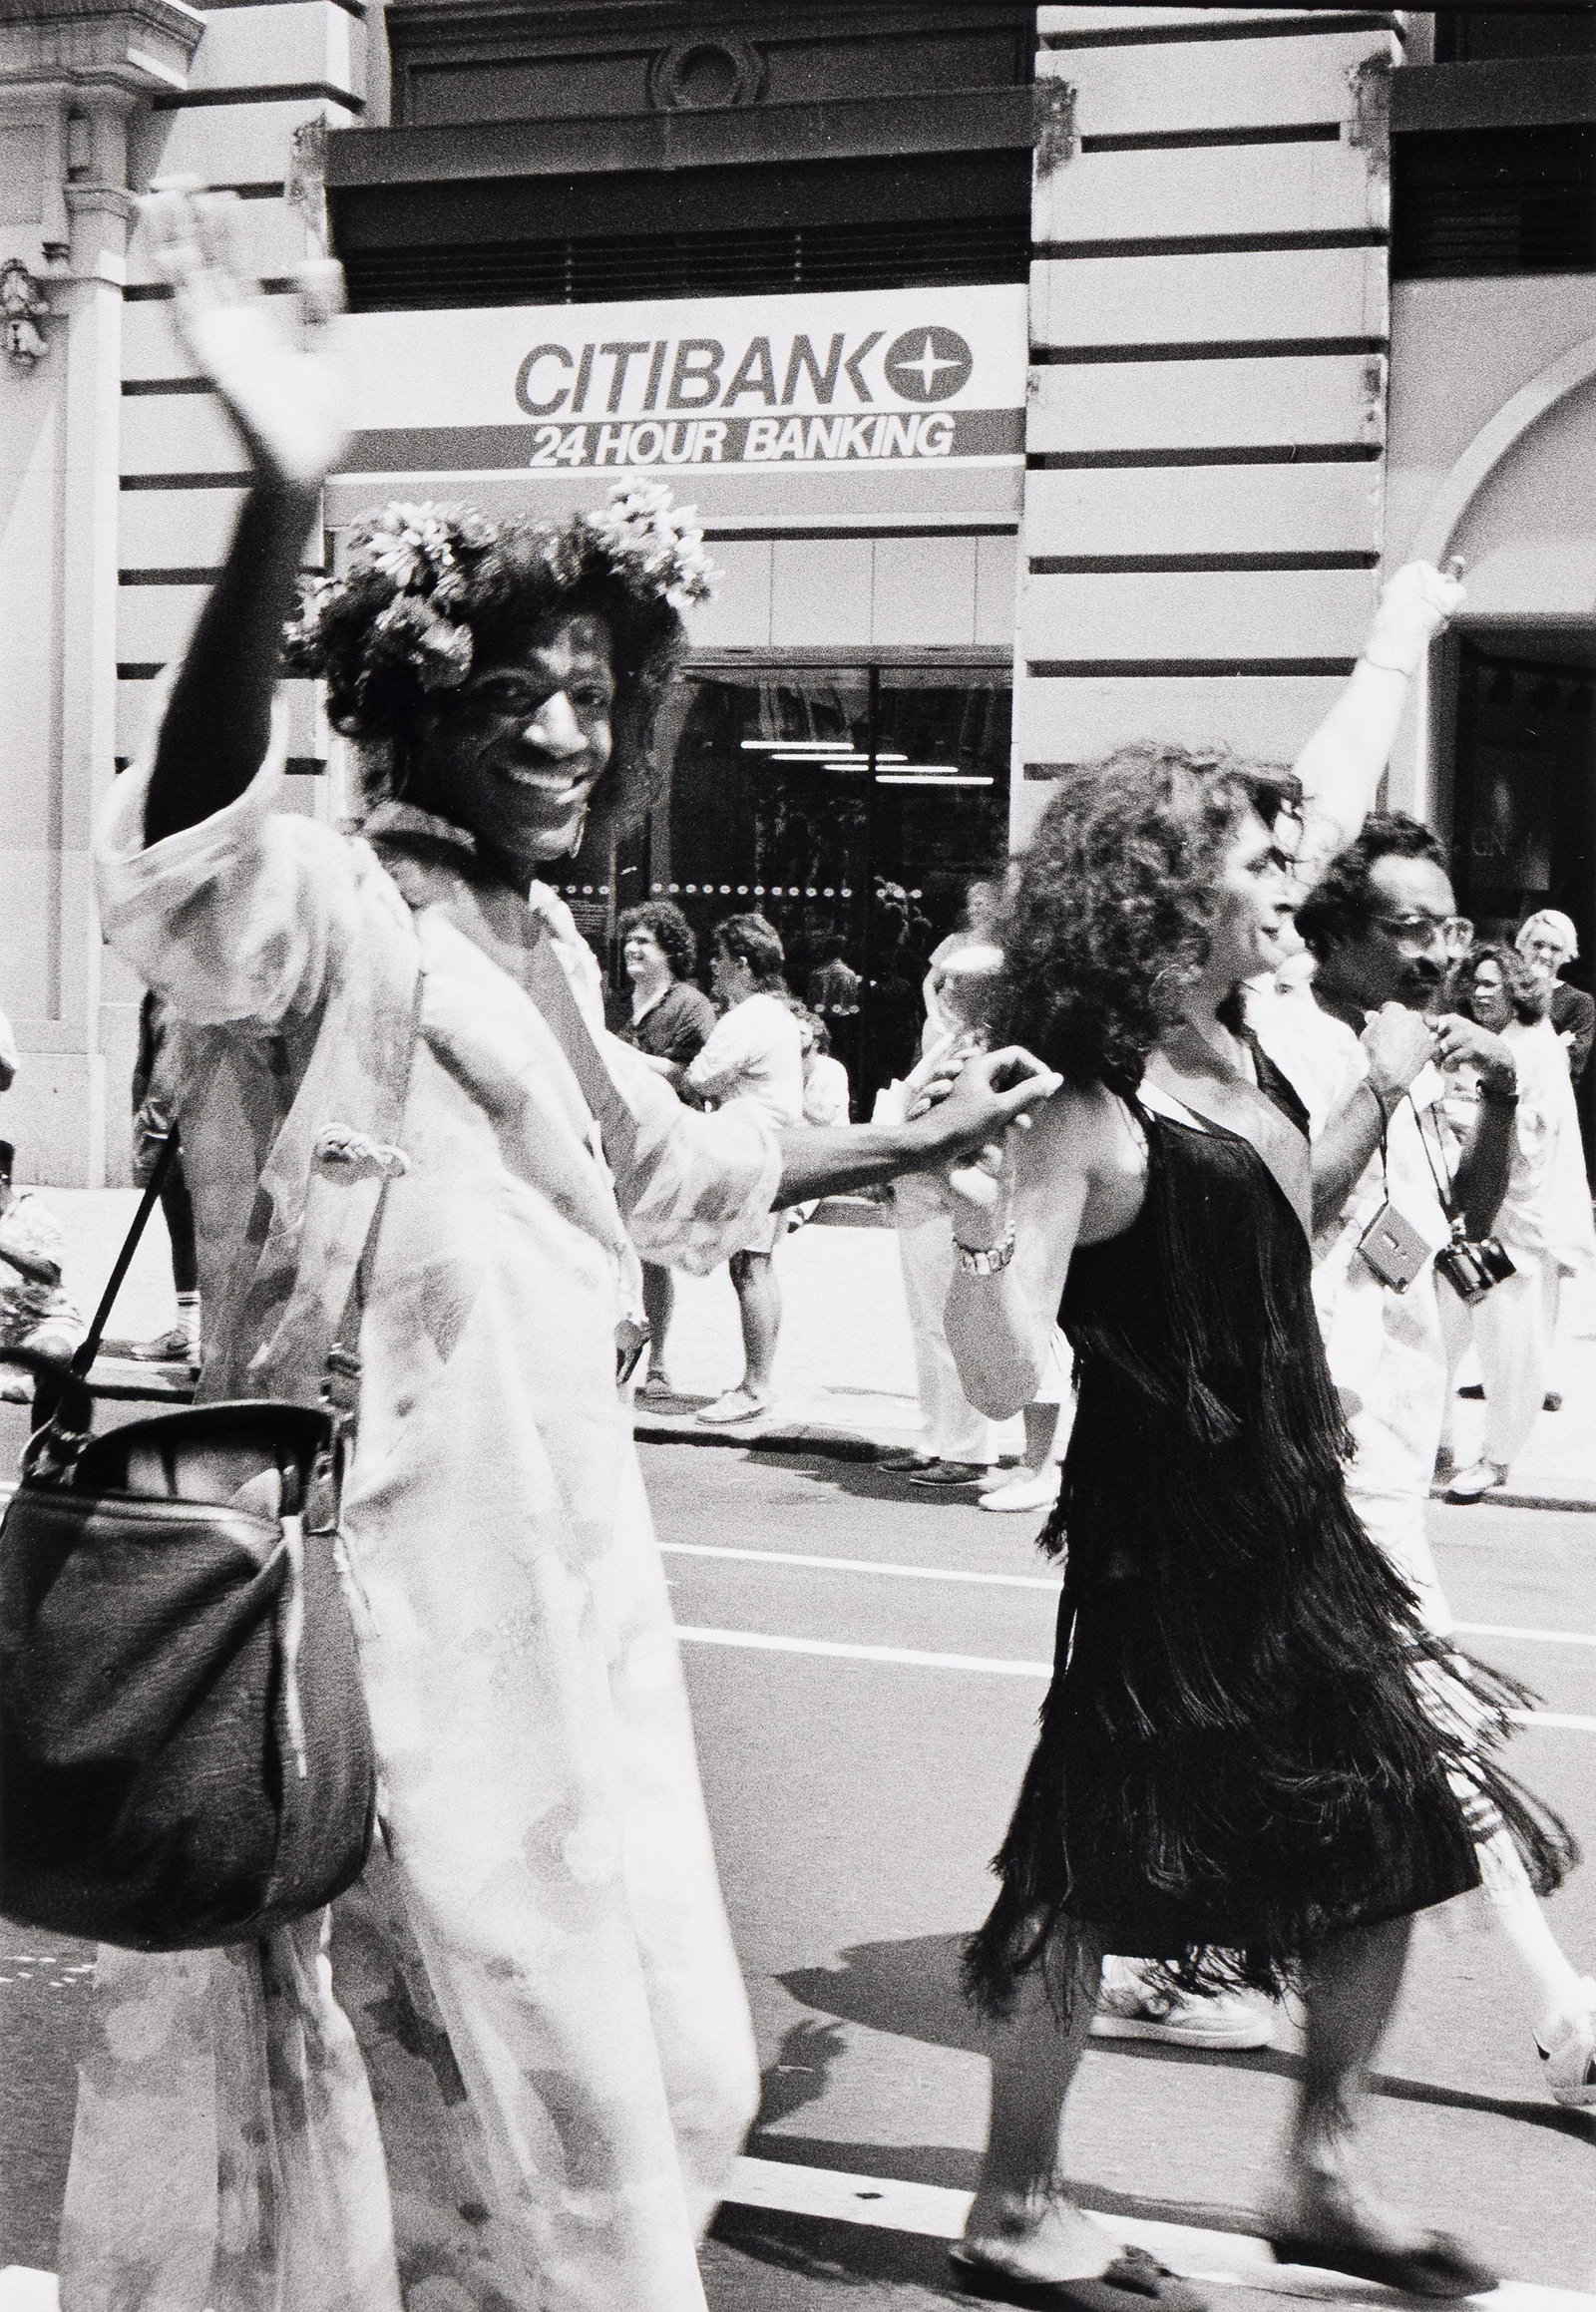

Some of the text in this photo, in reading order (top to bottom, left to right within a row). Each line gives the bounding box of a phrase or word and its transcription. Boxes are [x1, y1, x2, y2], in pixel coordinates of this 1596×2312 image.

[515, 331, 886, 417] CITIBANK
[531, 413, 955, 467] 24 HOUR BANKING
